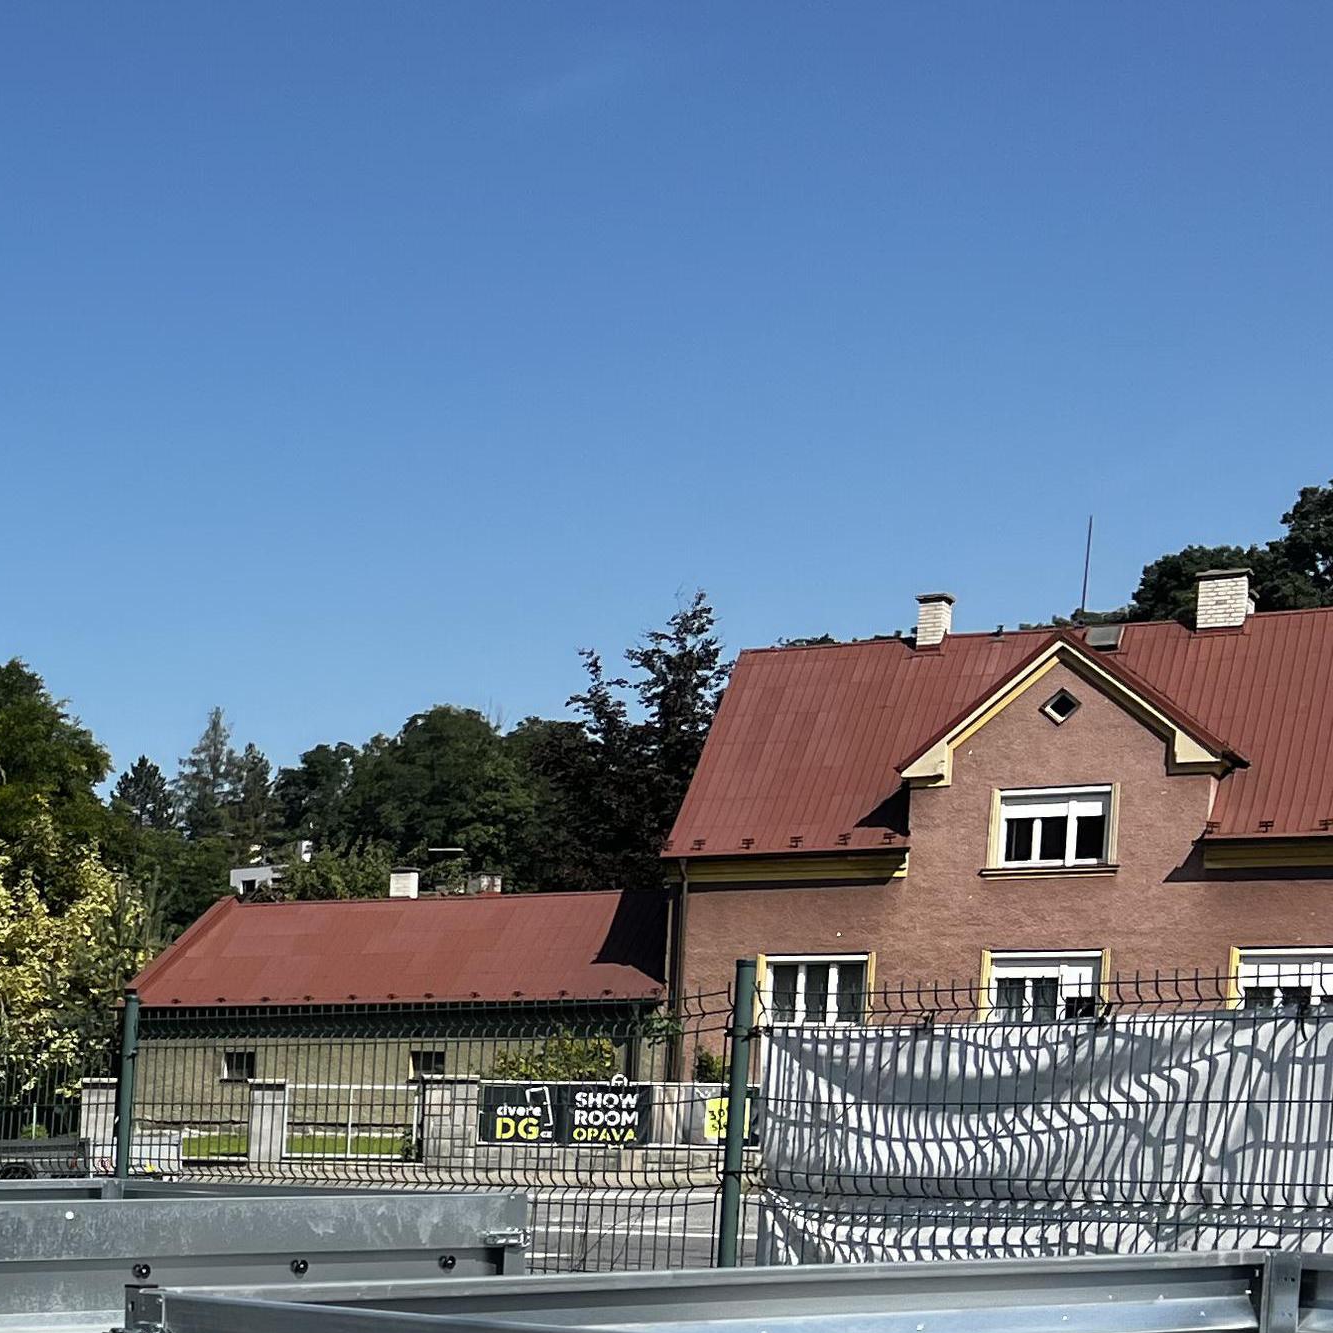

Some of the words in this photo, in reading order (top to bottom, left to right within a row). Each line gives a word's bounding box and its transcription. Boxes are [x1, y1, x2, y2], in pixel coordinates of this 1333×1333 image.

[575, 1092, 639, 1109] SHOW
[574, 1110, 639, 1126] ROOM
[572, 1128, 637, 1142] OPAVA
